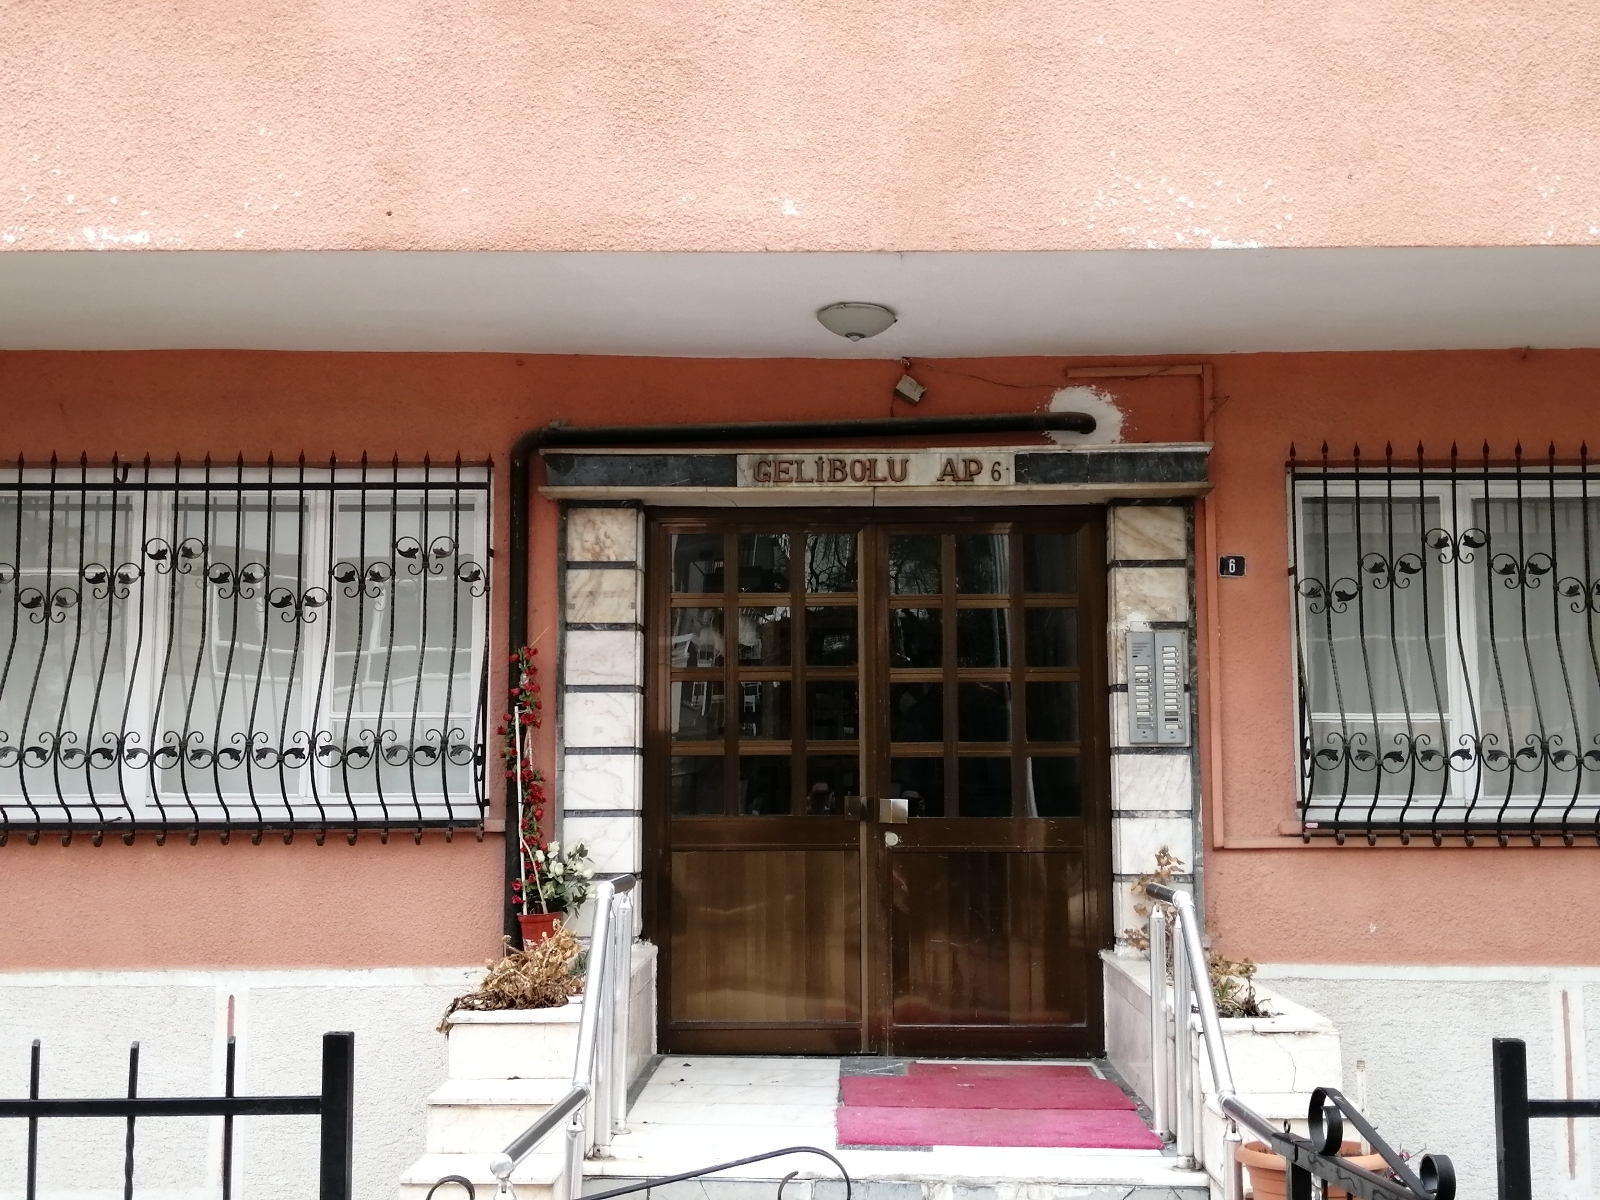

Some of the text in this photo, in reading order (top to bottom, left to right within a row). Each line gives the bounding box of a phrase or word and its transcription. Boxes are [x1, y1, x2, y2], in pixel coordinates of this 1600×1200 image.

[753, 456, 1002, 483] GELİBOLU AP 6
[1228, 558, 1236, 573] 6
